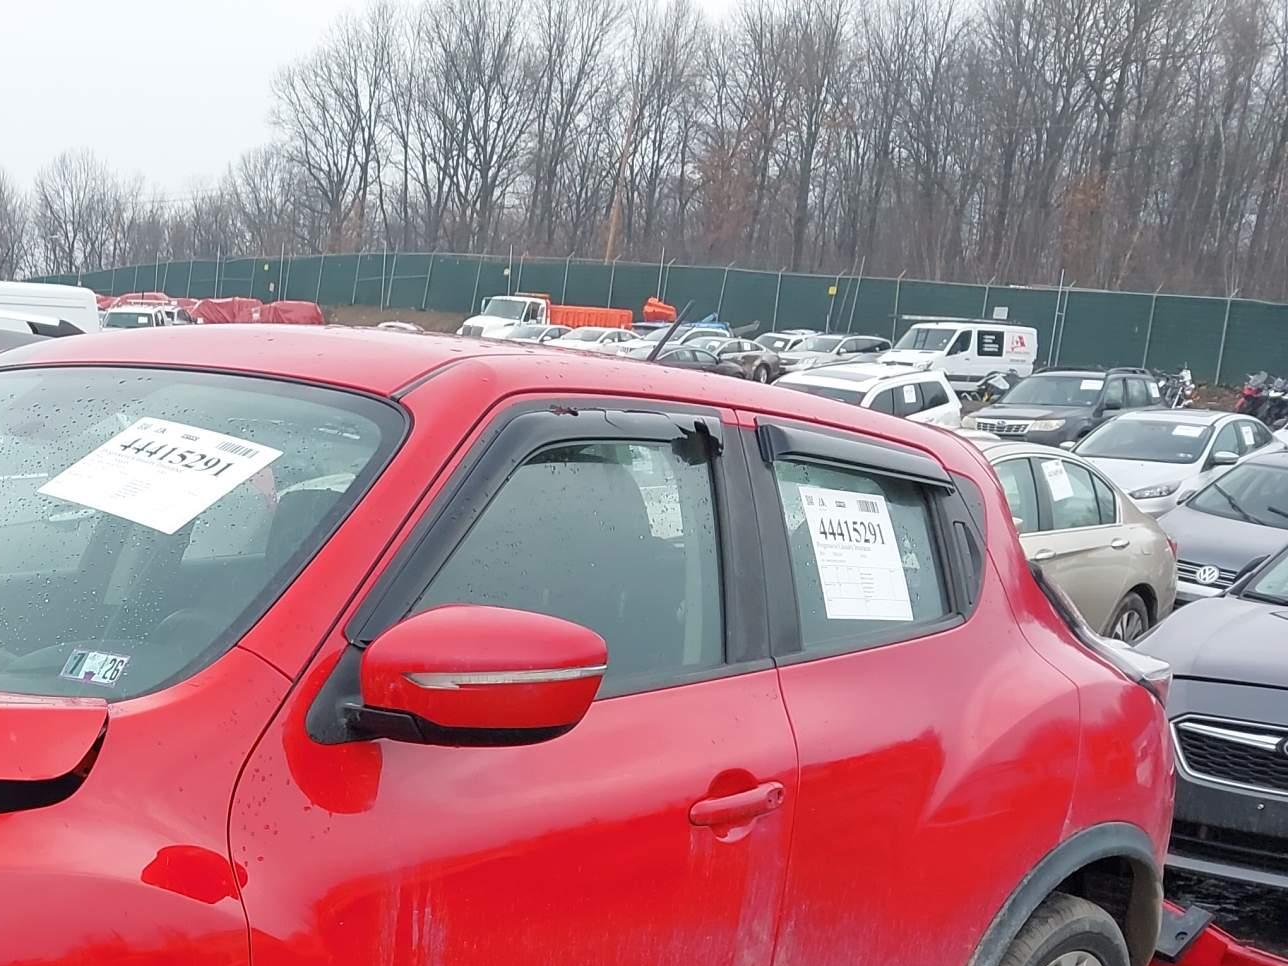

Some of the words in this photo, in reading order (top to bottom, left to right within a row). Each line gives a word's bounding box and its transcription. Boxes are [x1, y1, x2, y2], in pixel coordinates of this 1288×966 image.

[120, 437, 235, 477] 44415291
[819, 517, 885, 545] 44415291
[102, 658, 124, 681] 26
